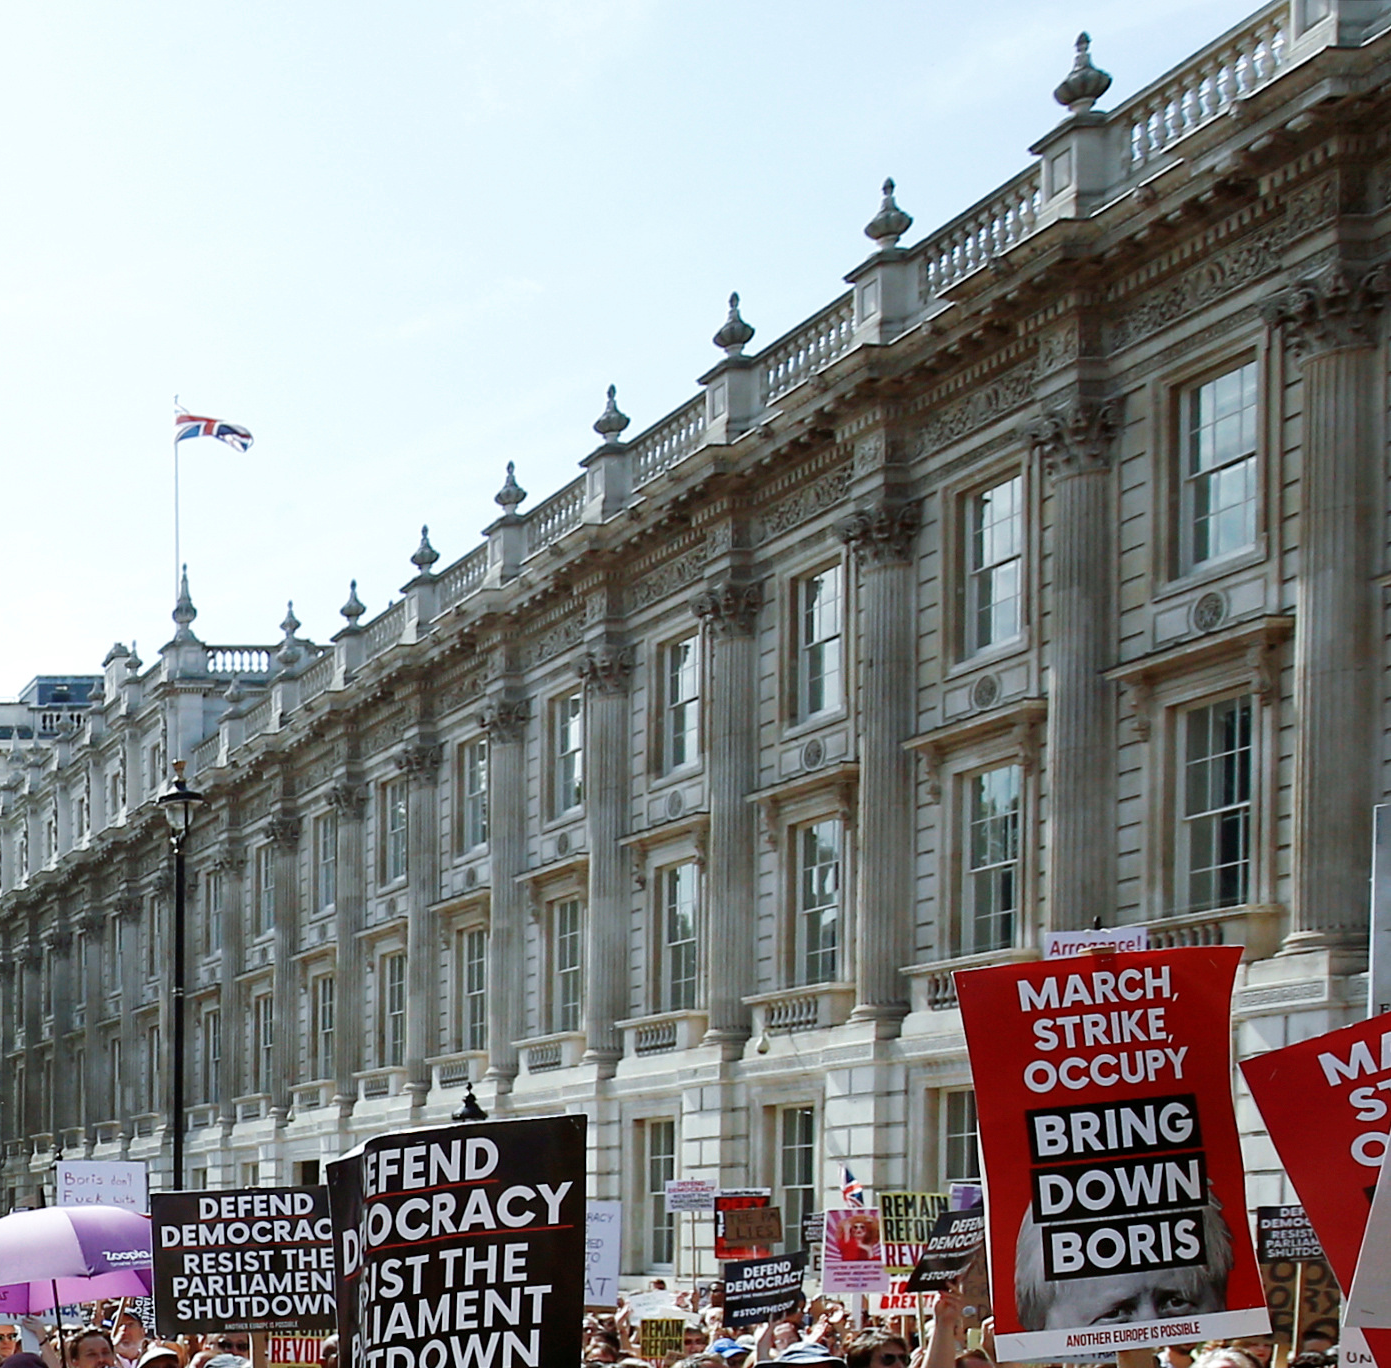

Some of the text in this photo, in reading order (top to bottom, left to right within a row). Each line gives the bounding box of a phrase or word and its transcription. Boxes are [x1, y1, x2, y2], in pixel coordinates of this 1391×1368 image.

[1017, 965, 1178, 1012] MARCH,
[1032, 1007, 1173, 1051] STRIKE,
[1024, 1046, 1188, 1093] OCCUPY
[1033, 1102, 1194, 1157] BRING
[64, 1172, 102, 1186] Boris
[1038, 1159, 1202, 1216] DOWN
[64, 1190, 101, 1203] Fuck
[199, 1193, 314, 1220] DEFEND
[881, 1195, 948, 1217] REMAIN
[161, 1217, 333, 1248] DEMOCRAC
[737, 1225, 774, 1239] LIES
[1051, 1219, 1200, 1274] BORIS
[183, 1246, 334, 1275] RESIST THE
[439, 1242, 529, 1288] THE
[743, 1261, 791, 1278] DEFEND
[172, 1270, 334, 1298] PARLIAMEN
[725, 1269, 804, 1294] DEMOCRACY
[176, 1293, 337, 1320] SHUTDOWN
[732, 1301, 794, 1318] #STOPTHECOUP
[224, 1322, 249, 1330] ANOTHER
[250, 1321, 268, 1329] EUROPE
[642, 1320, 684, 1338] REMAIN
[1066, 1322, 1200, 1347] ANOTHER EUROPE IS POSSIBLE
